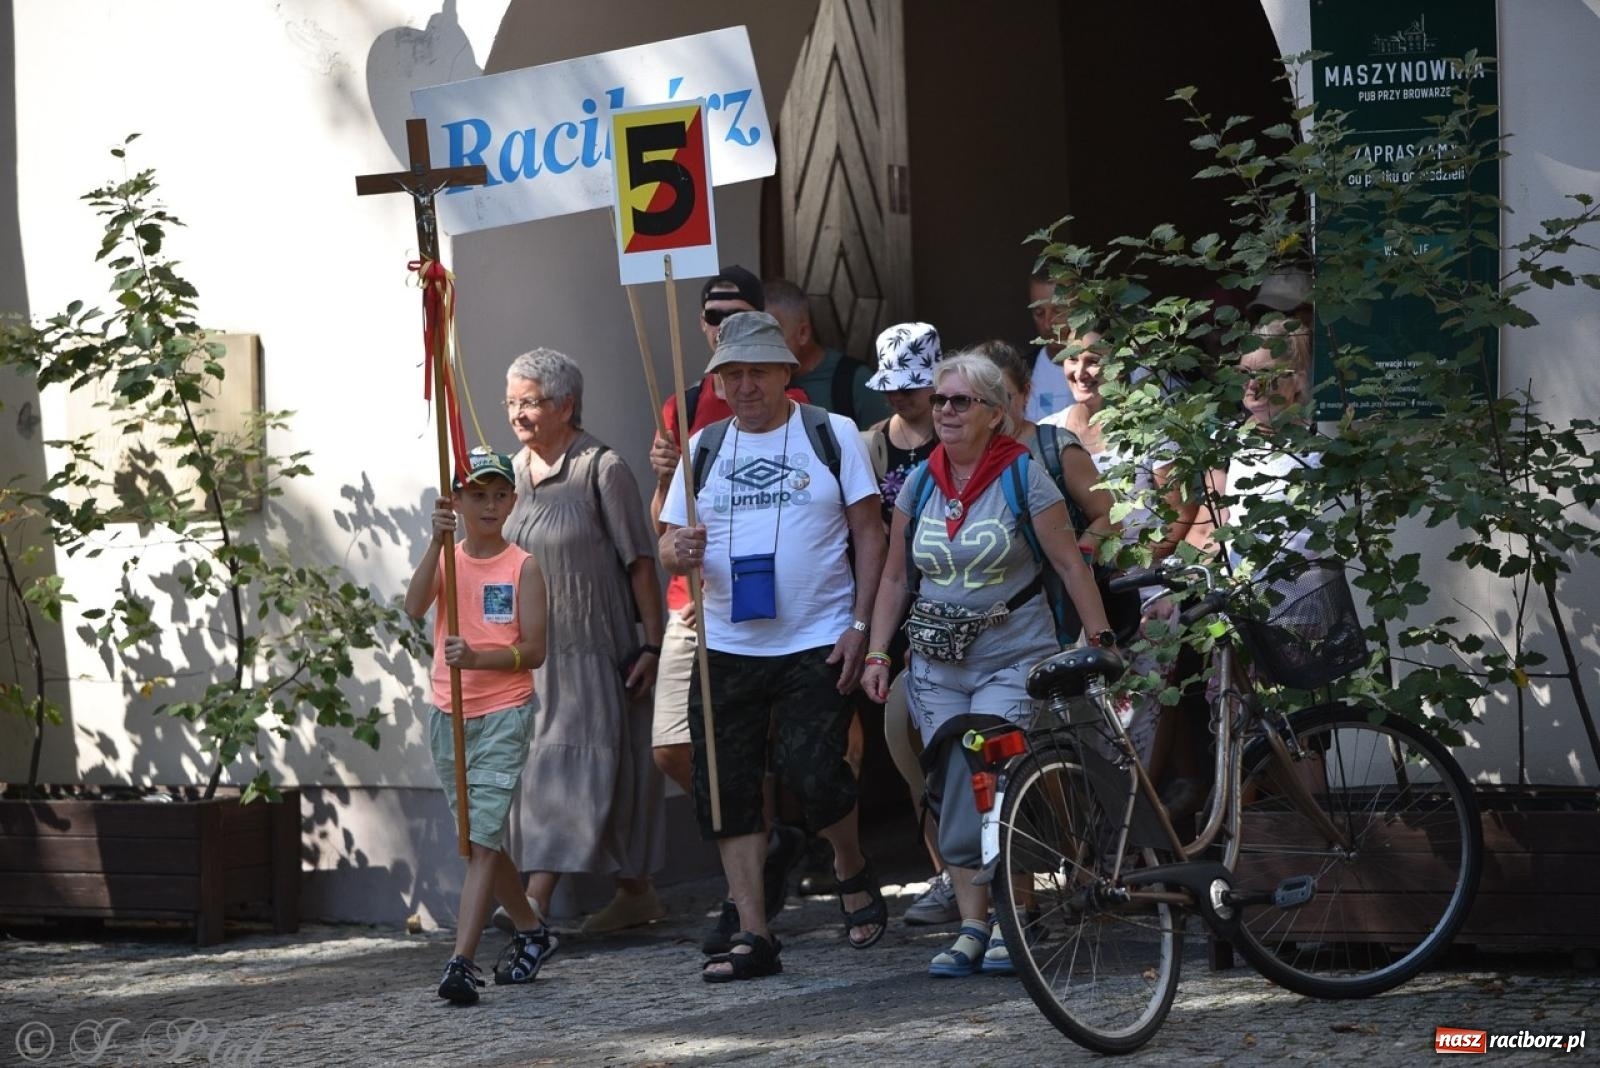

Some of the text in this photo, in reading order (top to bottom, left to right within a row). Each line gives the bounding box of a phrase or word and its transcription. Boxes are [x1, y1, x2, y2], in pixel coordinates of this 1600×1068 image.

[1358, 86, 1452, 102] PUB PRZY BROWARZE
[442, 77, 761, 195] Racirz
[625, 120, 696, 237] 5
[731, 490, 791, 507] umbro
[912, 516, 1011, 589] 52
